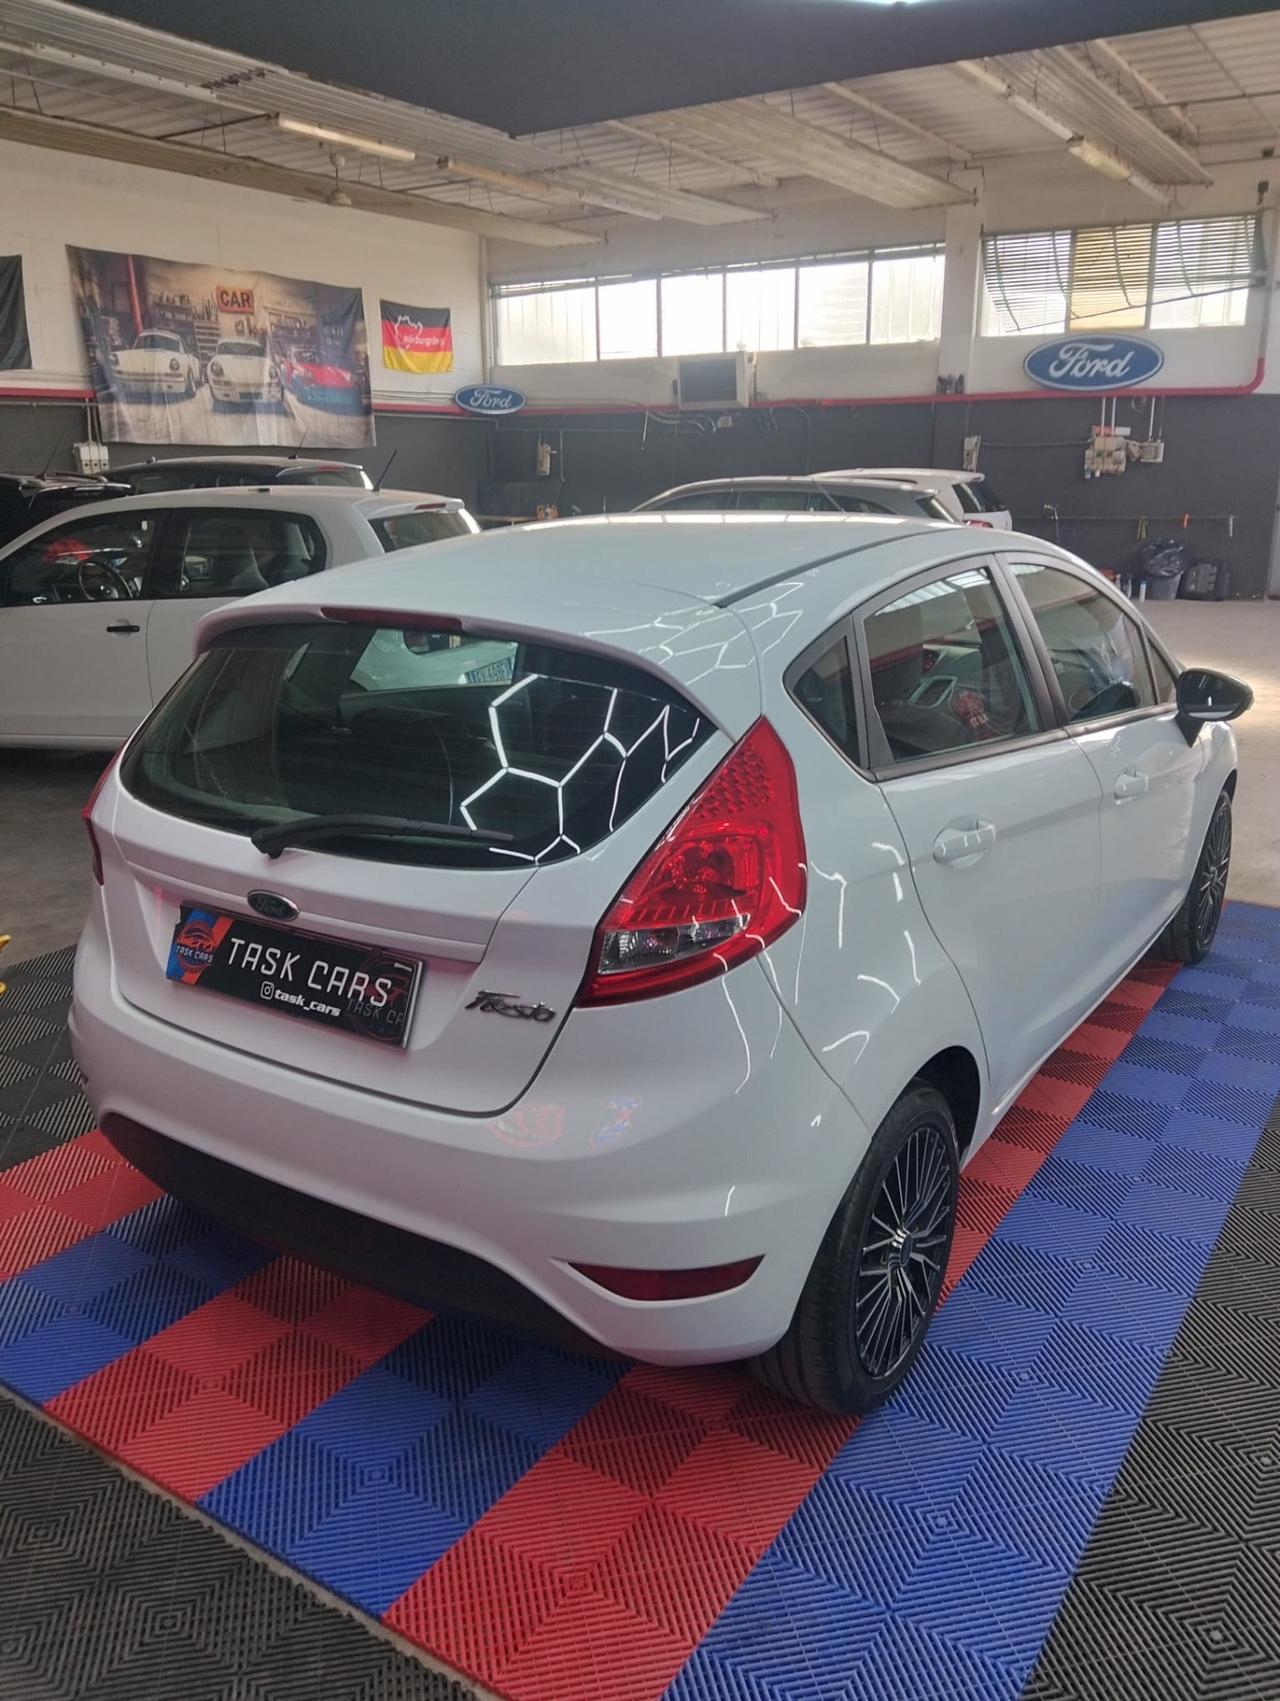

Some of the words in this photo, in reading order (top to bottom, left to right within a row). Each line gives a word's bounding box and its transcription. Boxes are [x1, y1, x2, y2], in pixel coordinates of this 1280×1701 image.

[220, 290, 252, 308] CAR
[1049, 342, 1135, 378] Ford
[470, 389, 513, 408] Ford
[175, 945, 193, 957] TASK
[194, 950, 215, 964] CARS
[228, 938, 301, 982] TASK
[307, 960, 392, 1008] CARS
[274, 989, 342, 1018] task_cars
